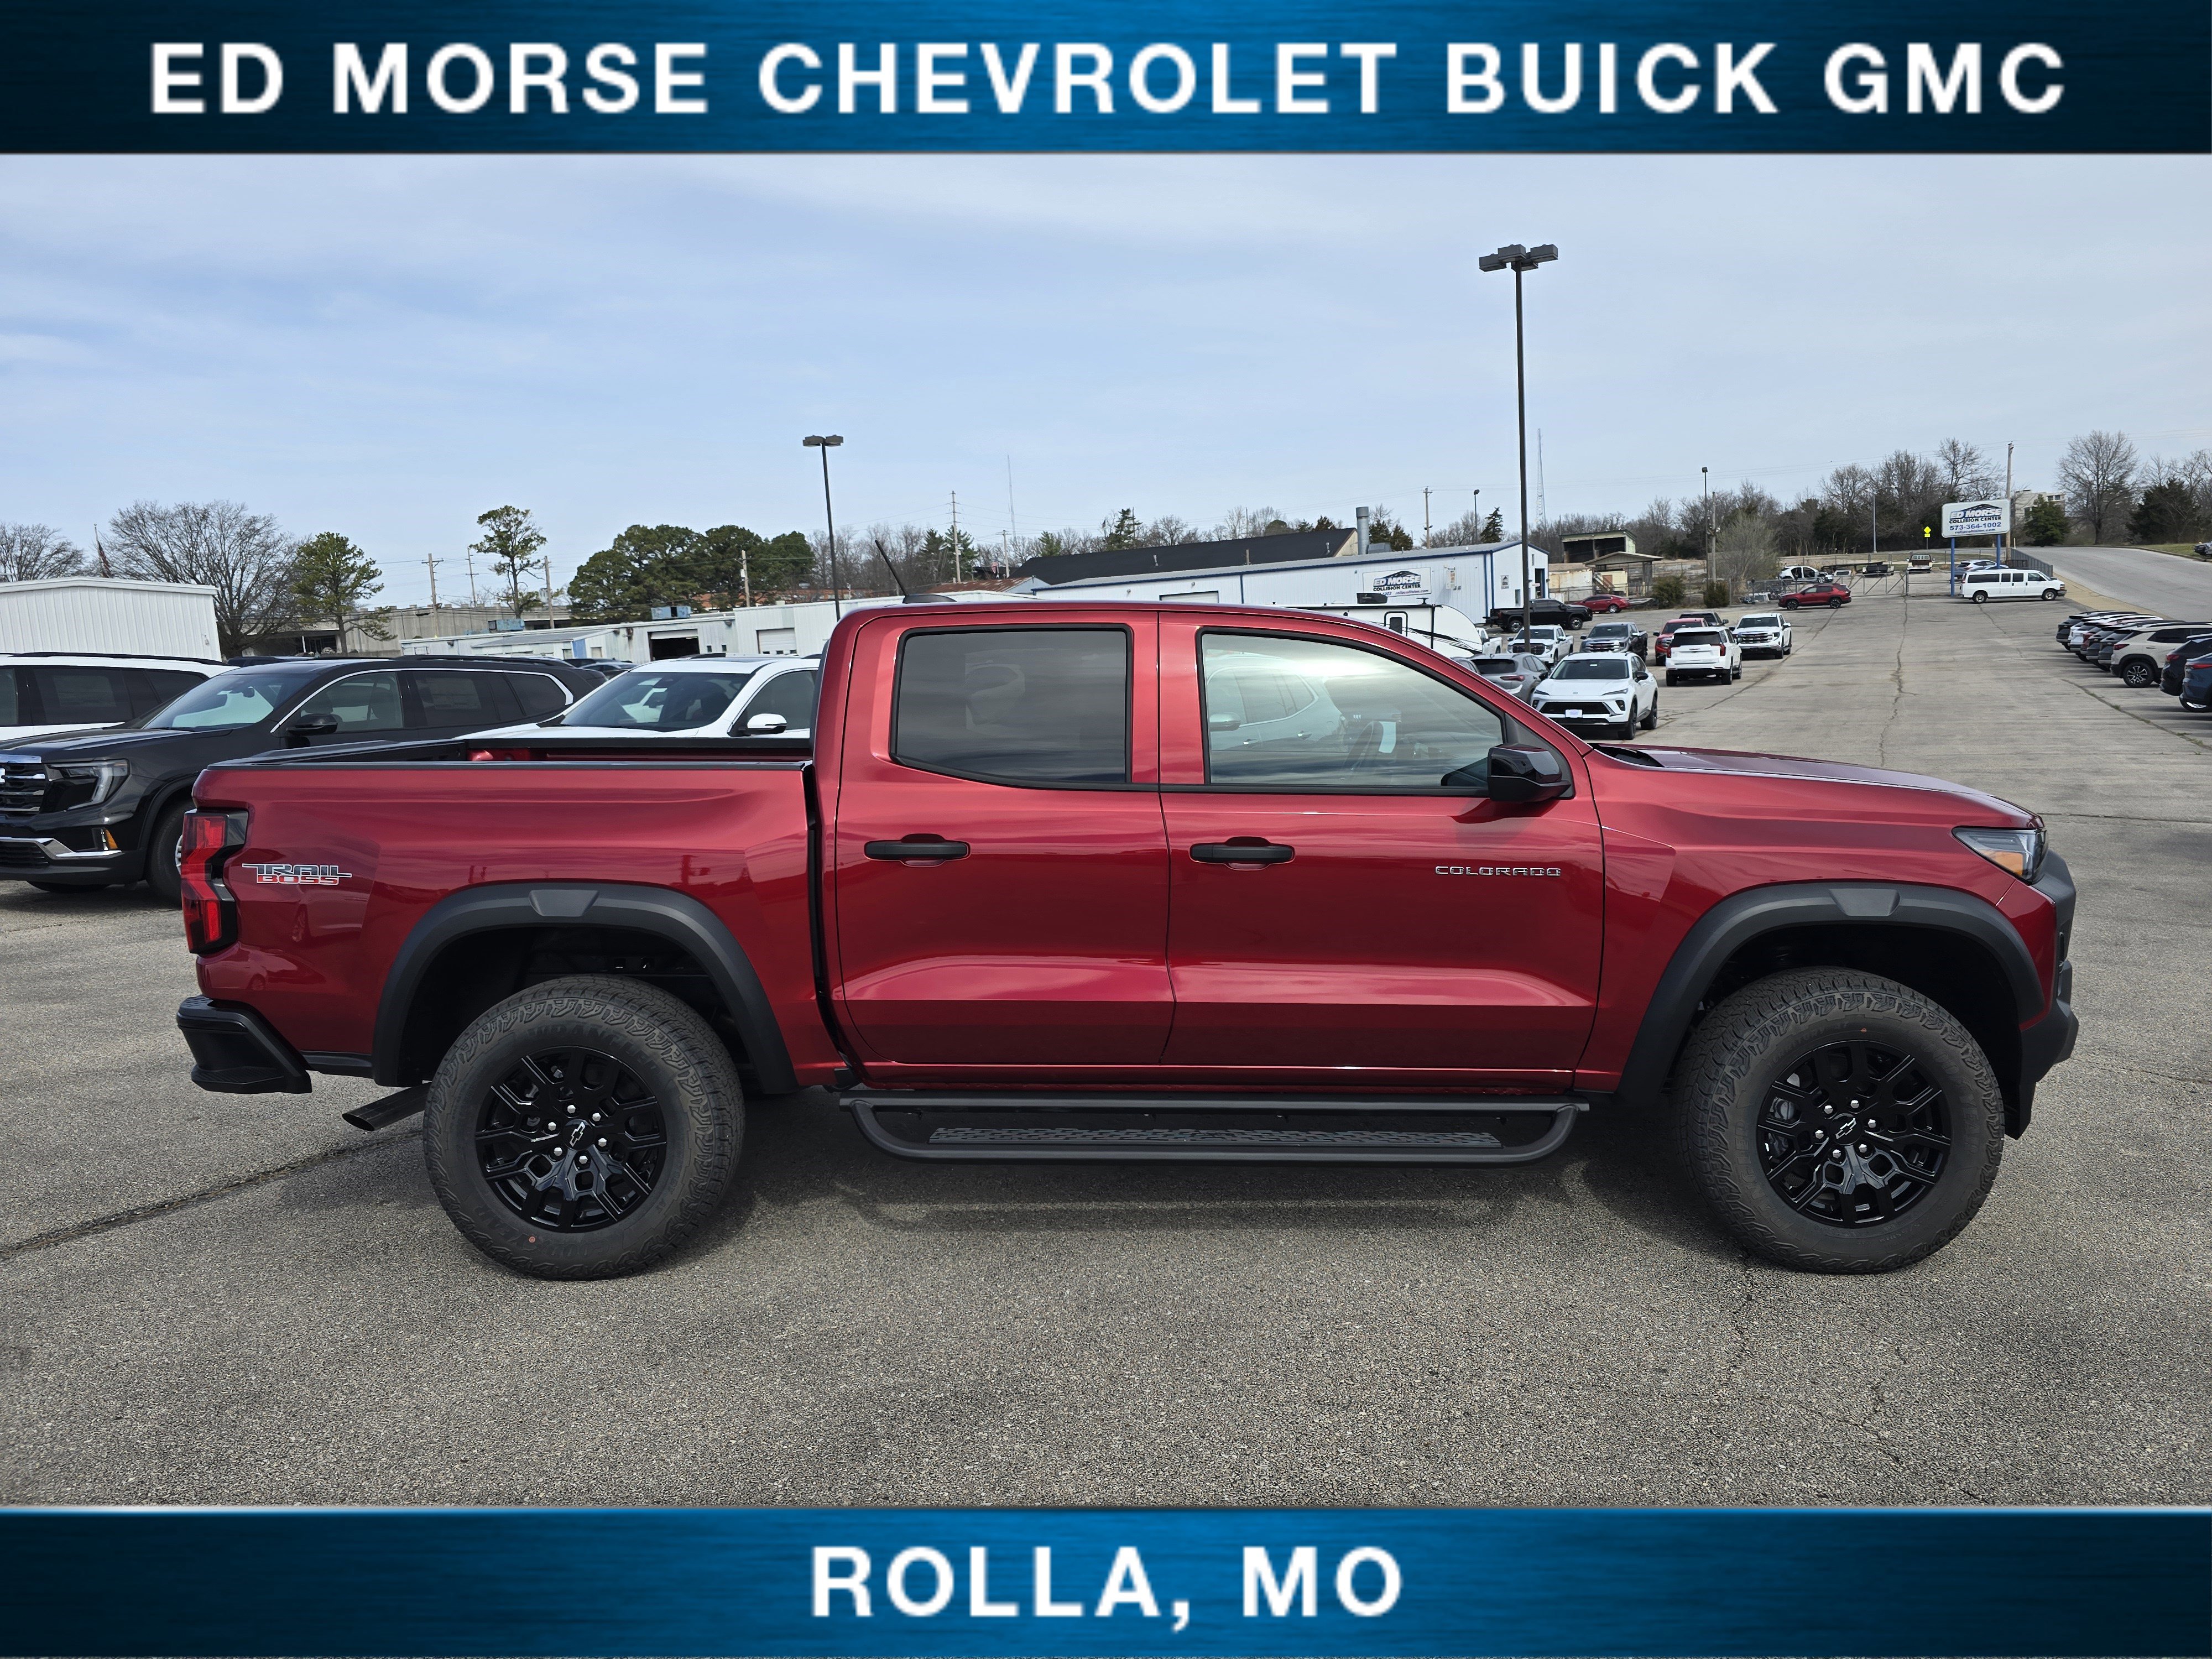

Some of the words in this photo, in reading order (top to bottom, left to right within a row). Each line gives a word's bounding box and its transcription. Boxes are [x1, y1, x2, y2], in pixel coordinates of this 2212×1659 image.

[1950, 511, 1965, 519] ED
[1965, 508, 2002, 518] MORSE
[1949, 522, 2002, 531] 573-364-1002
[1374, 578, 1387, 586] ED
[1387, 574, 1421, 585] MORSE
[242, 863, 352, 878] TRAIL
[1435, 865, 1561, 877] COLORADO
[256, 874, 340, 885] BOSS
